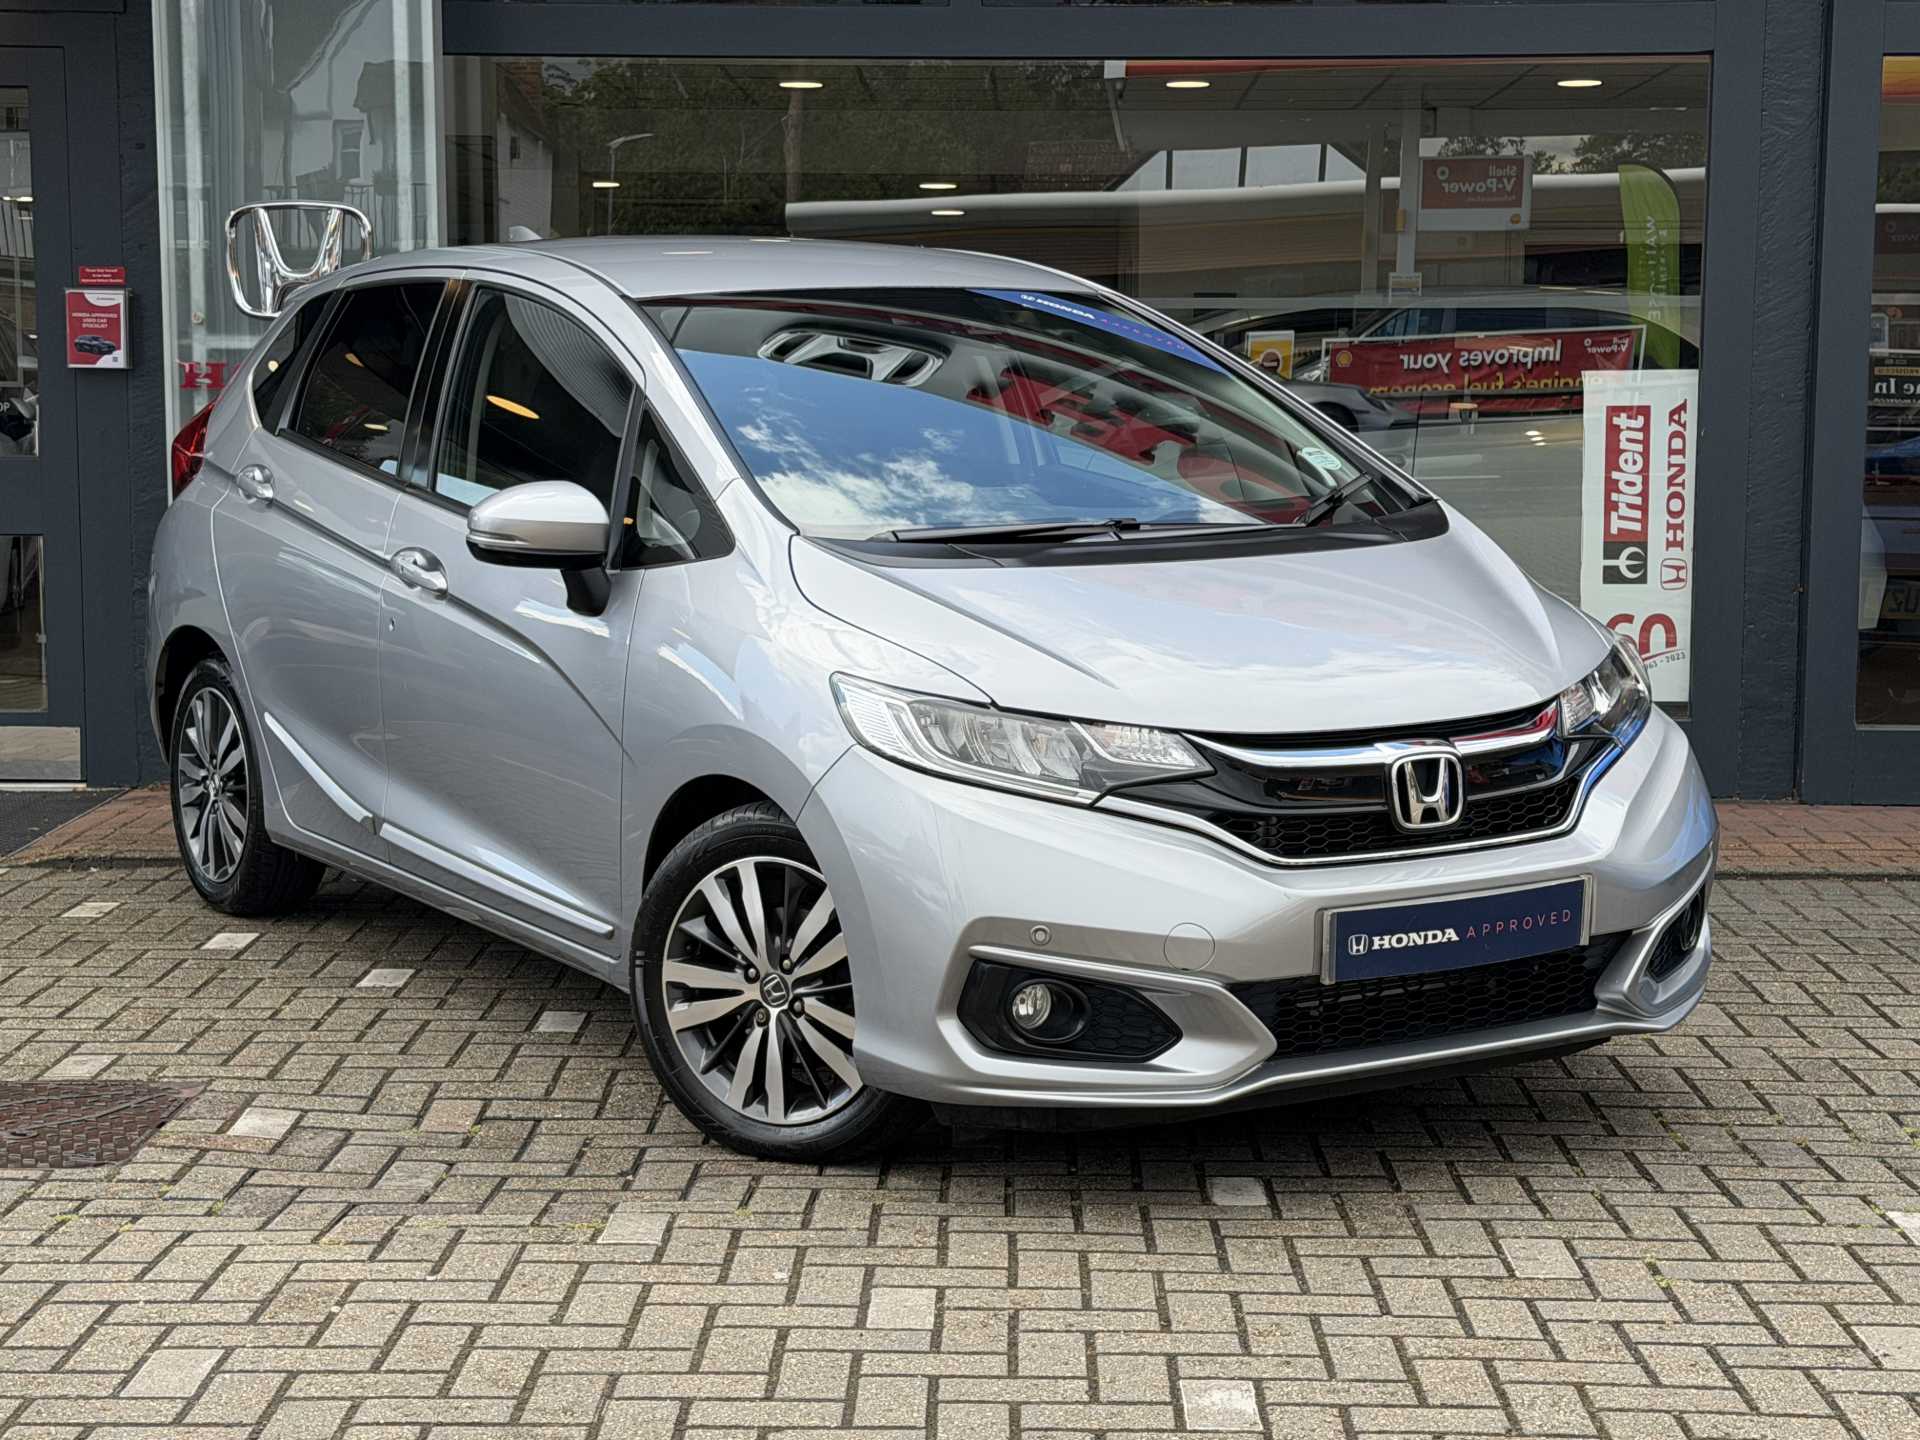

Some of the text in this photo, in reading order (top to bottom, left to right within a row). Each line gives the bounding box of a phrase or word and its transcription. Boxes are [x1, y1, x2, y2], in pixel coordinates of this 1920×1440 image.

[1610, 412, 1645, 535] Trident
[1666, 399, 1688, 552] HONDA
[1371, 927, 1460, 951] HONDA
[1466, 909, 1572, 939] APPROVED
